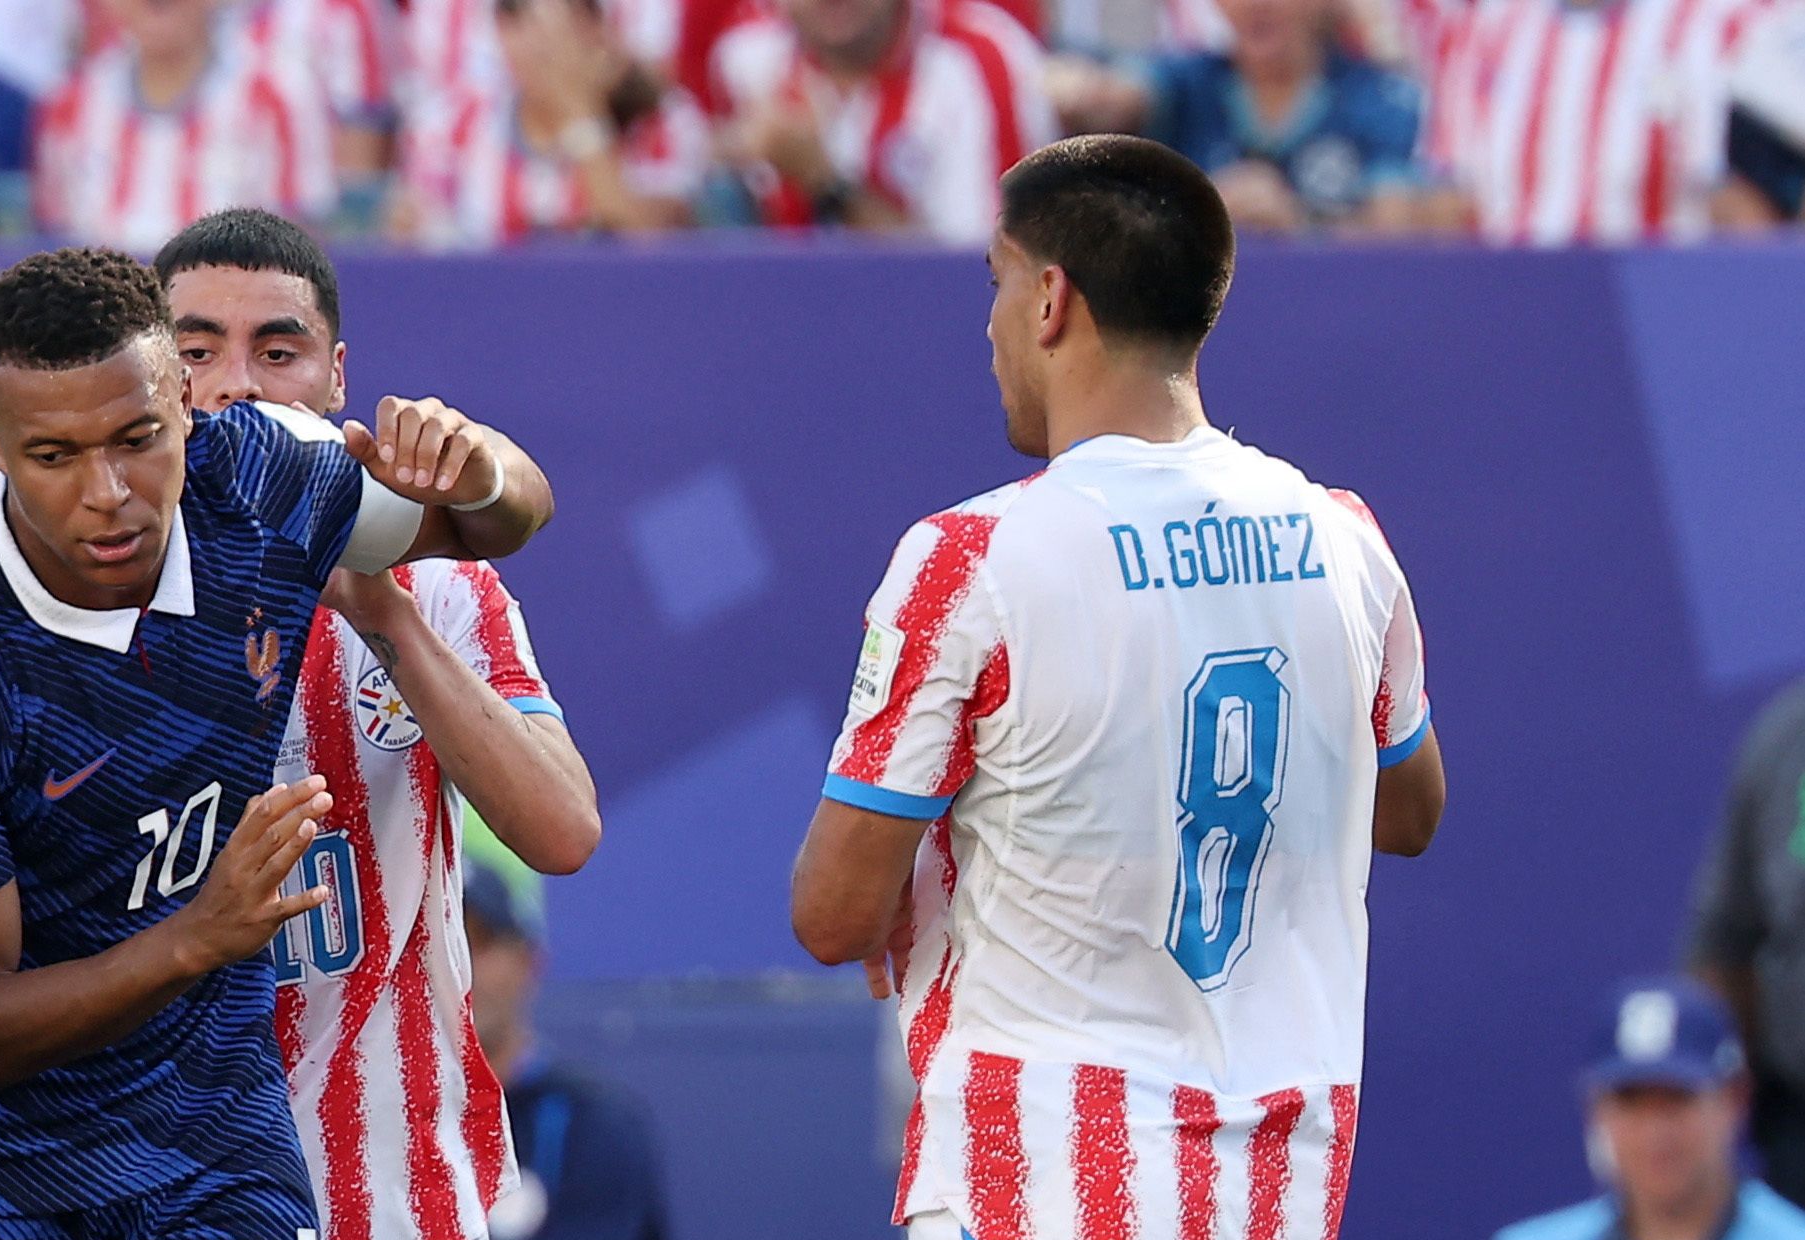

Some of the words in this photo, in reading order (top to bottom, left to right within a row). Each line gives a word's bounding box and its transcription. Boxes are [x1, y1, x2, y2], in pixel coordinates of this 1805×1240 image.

[1107, 500, 1326, 591] D.GÓMEZ
[371, 671, 392, 689] AP
[127, 780, 223, 911] 10
[1164, 645, 1291, 994] 8
